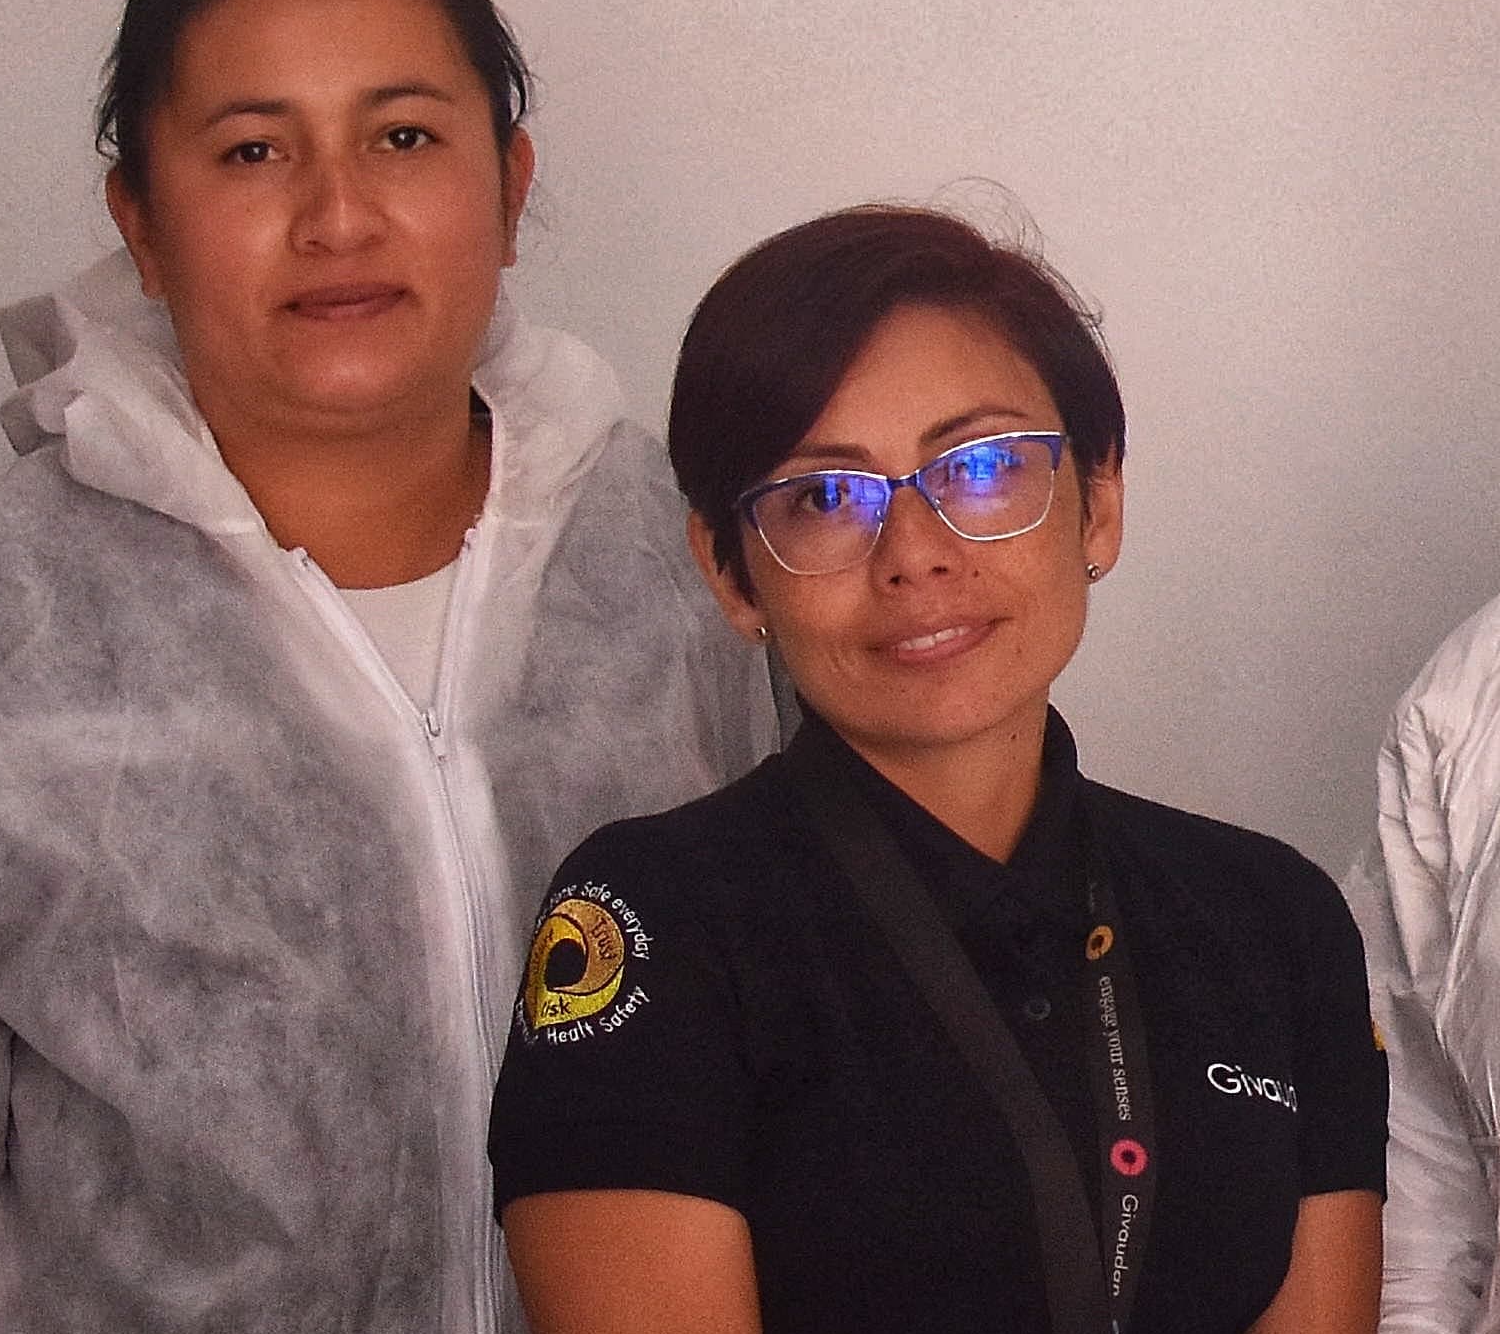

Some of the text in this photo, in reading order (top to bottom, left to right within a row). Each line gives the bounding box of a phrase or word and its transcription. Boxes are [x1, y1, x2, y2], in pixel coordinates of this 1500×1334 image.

[580, 880, 655, 961] Safe everyday
[599, 984, 651, 1034] Safety
[1102, 1028, 1125, 1065] your
[1113, 1068, 1131, 1121] senses
[1113, 1194, 1139, 1297] Givaudan
